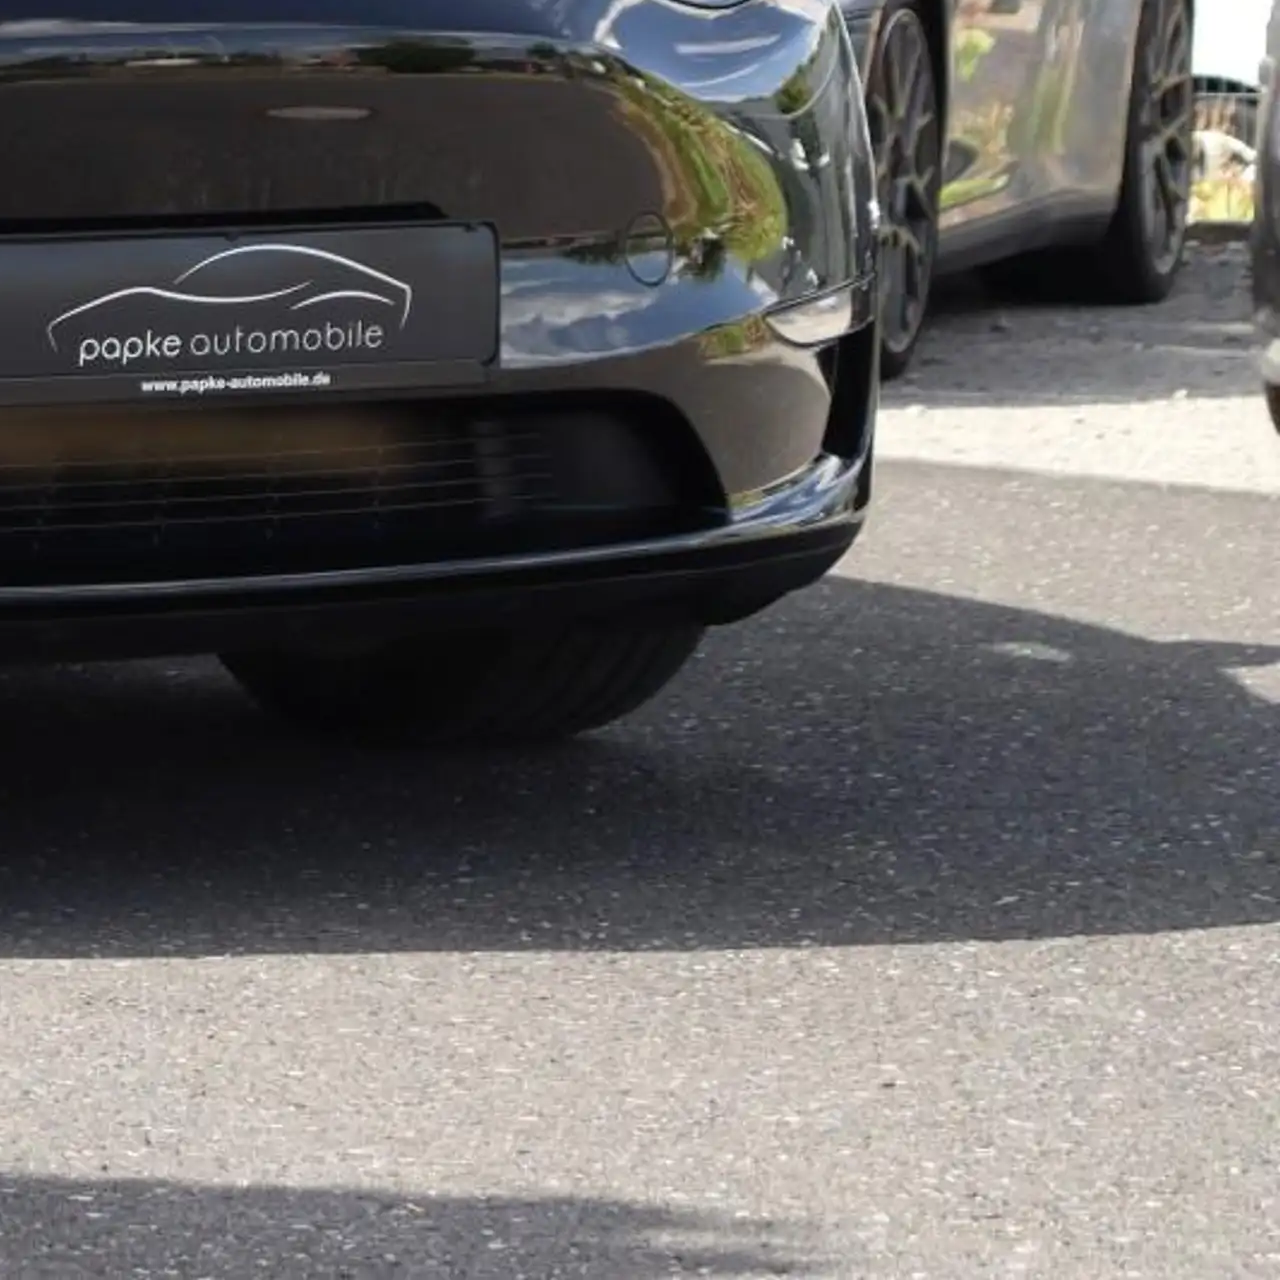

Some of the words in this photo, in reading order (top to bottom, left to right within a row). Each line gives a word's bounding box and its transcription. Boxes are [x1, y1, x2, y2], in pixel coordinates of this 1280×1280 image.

[79, 329, 183, 367] papke
[190, 319, 383, 356] automobile
[141, 373, 330, 395] www.papke-automobile.de
